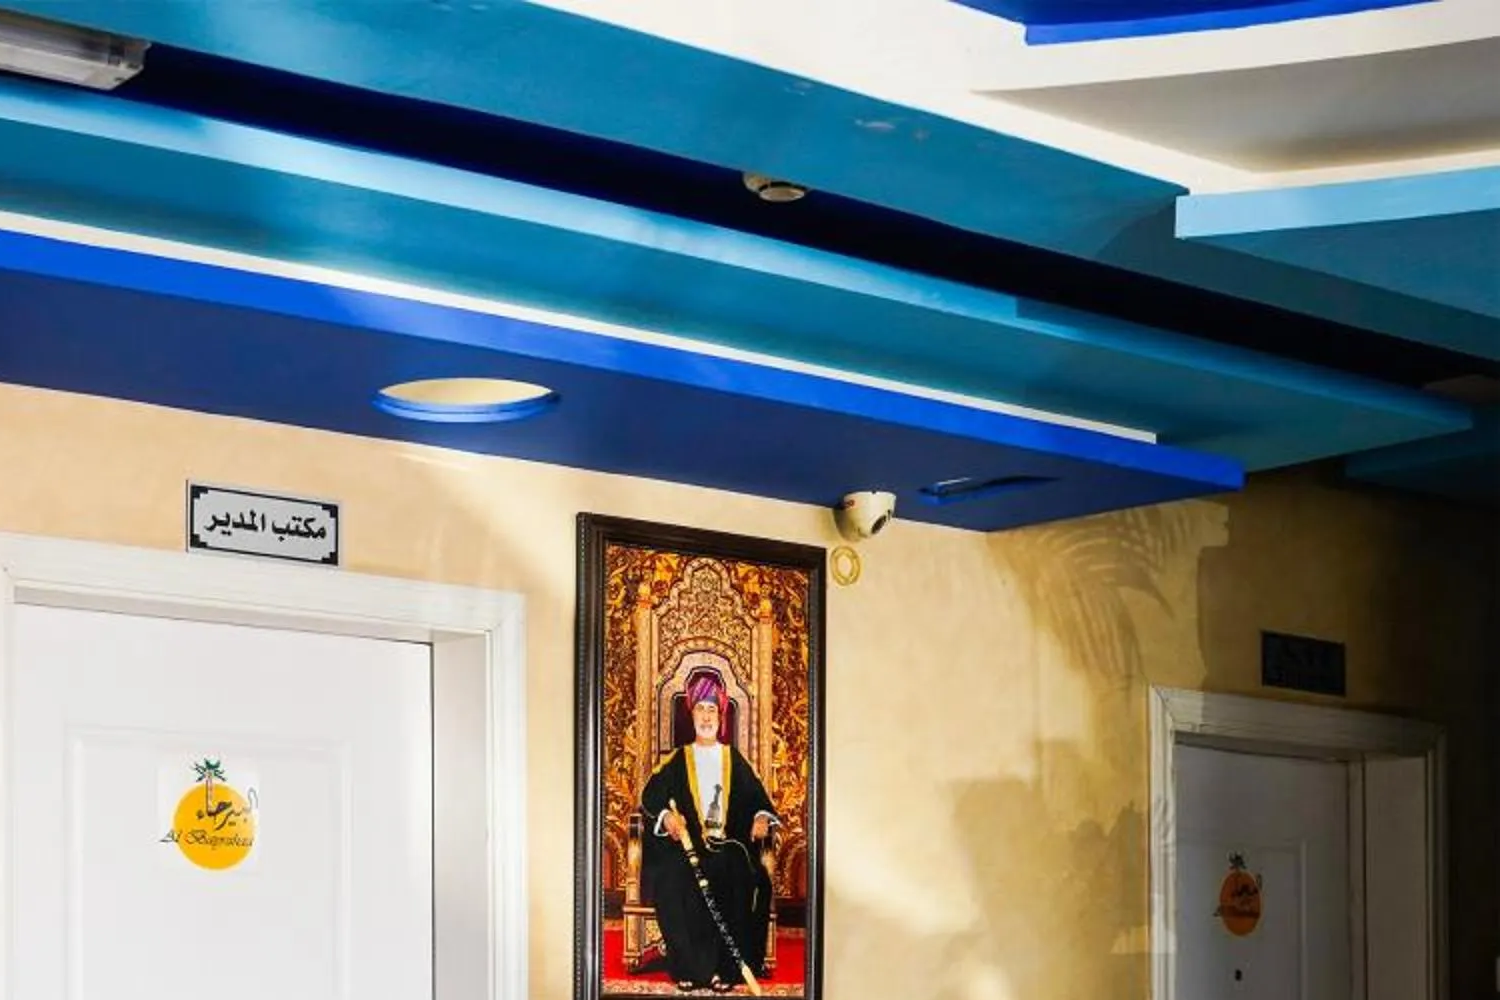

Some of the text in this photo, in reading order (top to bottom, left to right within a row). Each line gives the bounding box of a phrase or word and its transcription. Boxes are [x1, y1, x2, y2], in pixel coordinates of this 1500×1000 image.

[204, 509, 327, 541] مكتب المدير
[159, 829, 182, 843] Al
